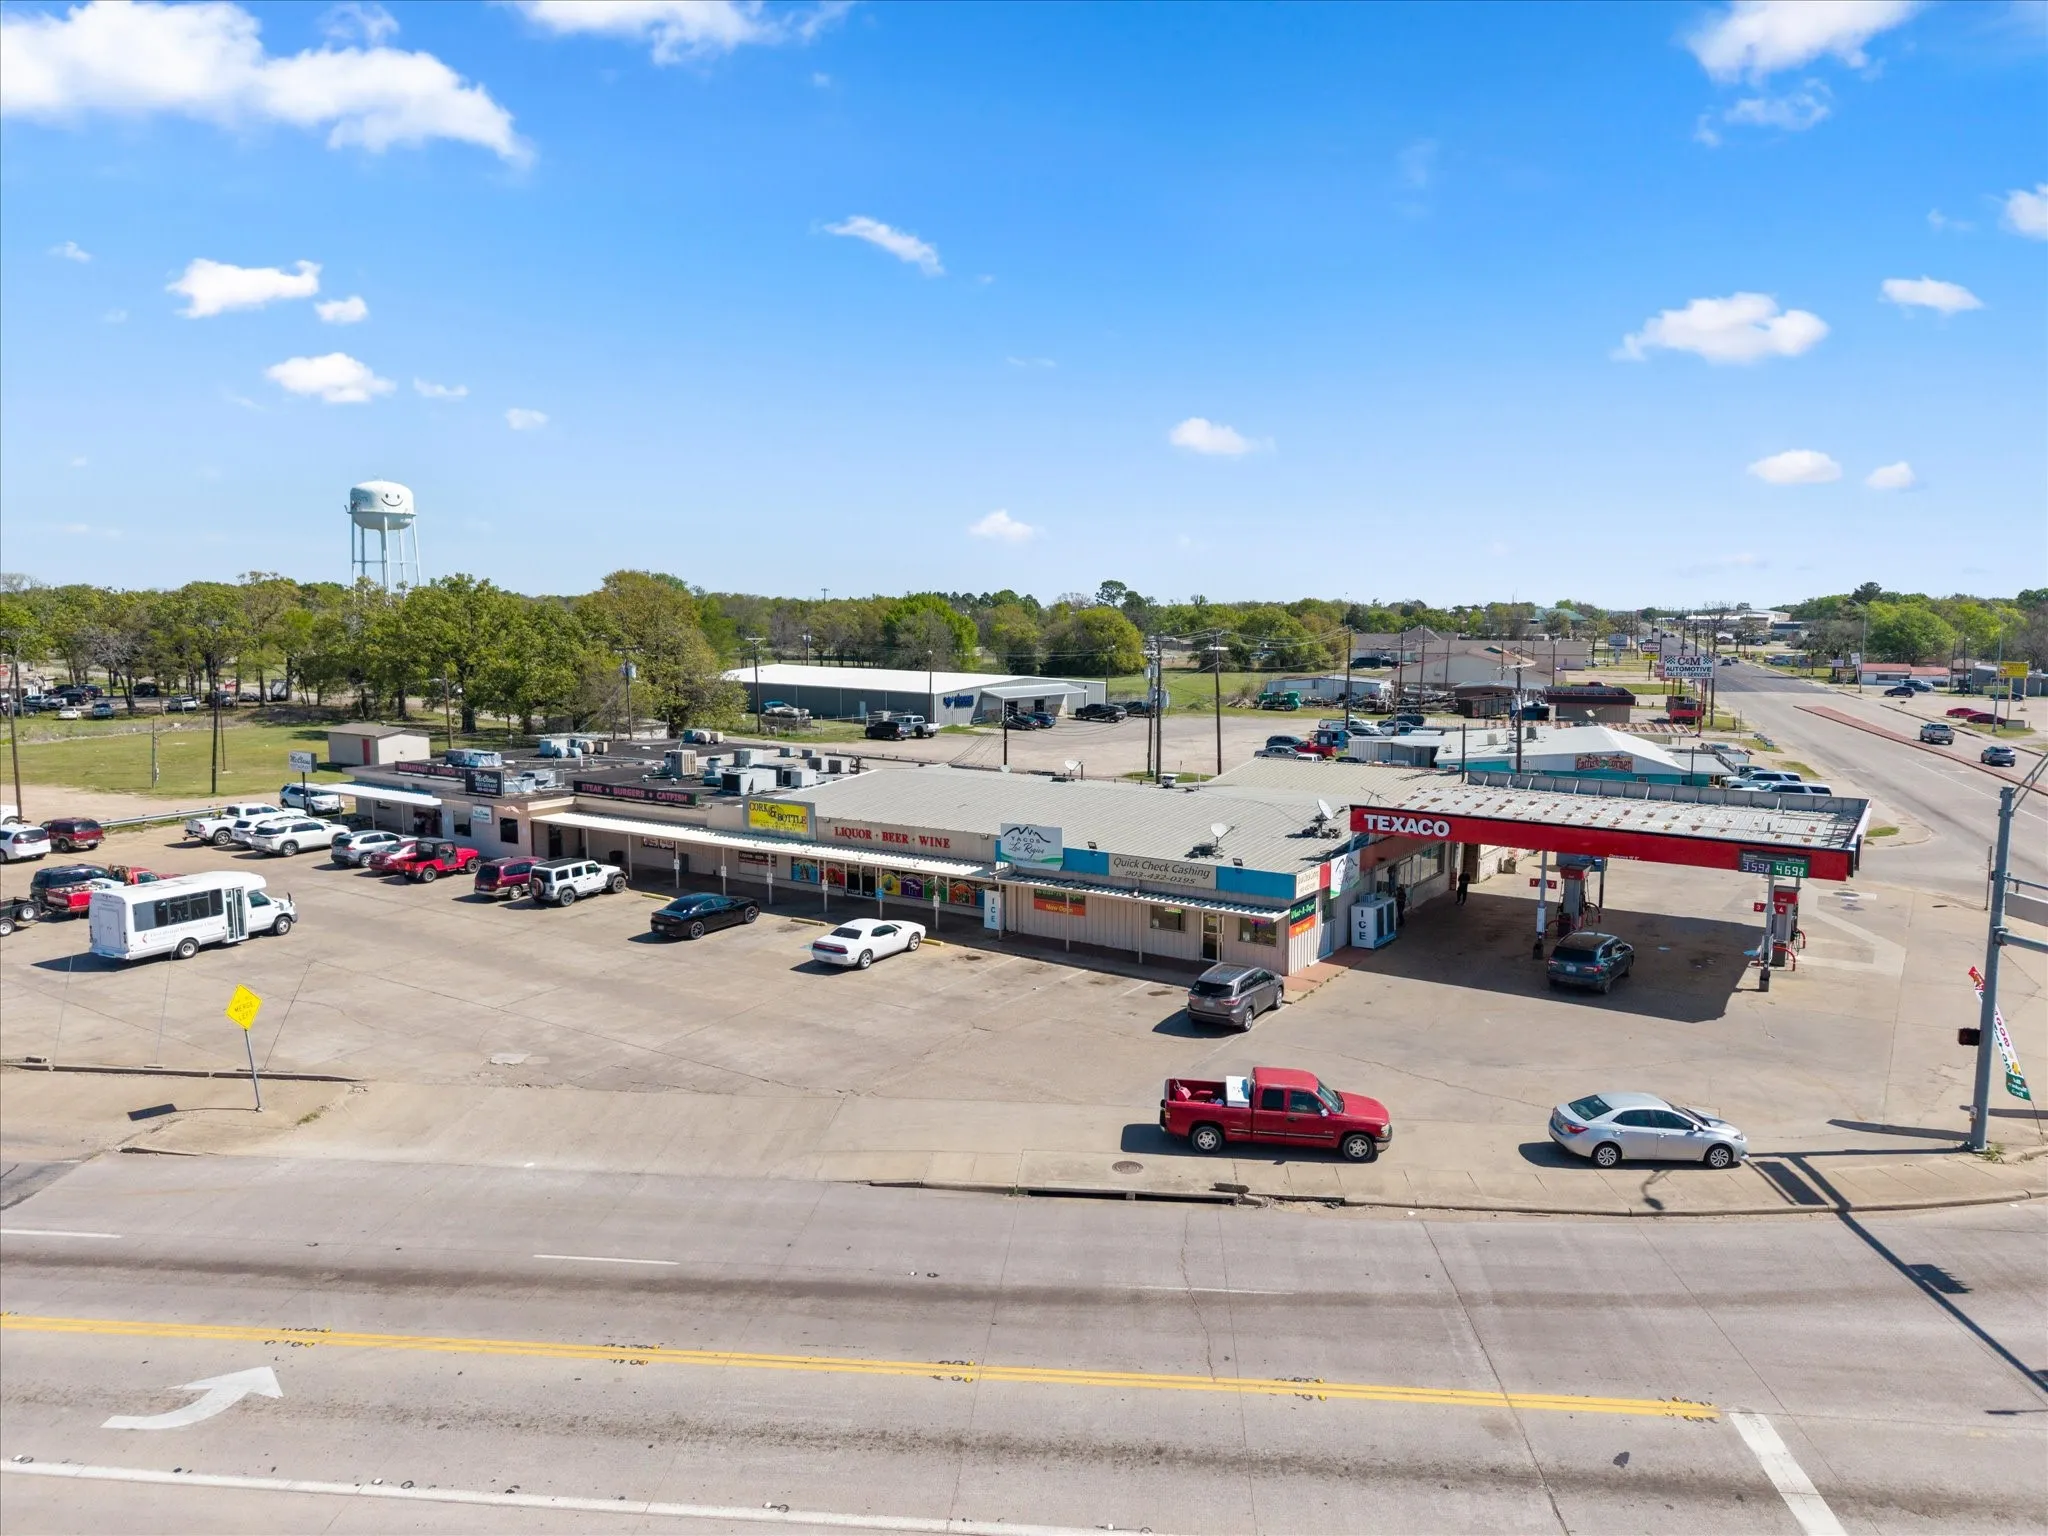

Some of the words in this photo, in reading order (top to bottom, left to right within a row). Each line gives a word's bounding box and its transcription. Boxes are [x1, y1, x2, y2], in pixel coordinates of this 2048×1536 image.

[1677, 656, 1701, 666] C&M
[399, 763, 428, 773] BREAKFAST
[437, 767, 456, 776] LUNCH
[581, 783, 603, 793] STEAK
[613, 788, 645, 798] BURGERS
[656, 792, 688, 803] CATFISH
[749, 801, 768, 812] CORK
[769, 803, 777, 818] &
[777, 813, 807, 825] BOTTLE
[1363, 813, 1450, 837] TEXACO
[834, 826, 873, 840] LIQUOR
[881, 831, 909, 845] BEER
[918, 835, 951, 849] WINE
[1010, 835, 1041, 844] TACOS
[1113, 857, 1140, 869] Quick
[1141, 860, 1170, 872] Check
[1171, 864, 1211, 880] Cashing
[1124, 870, 1197, 885] 903-432-0195
[1358, 909, 1367, 941] ICE
